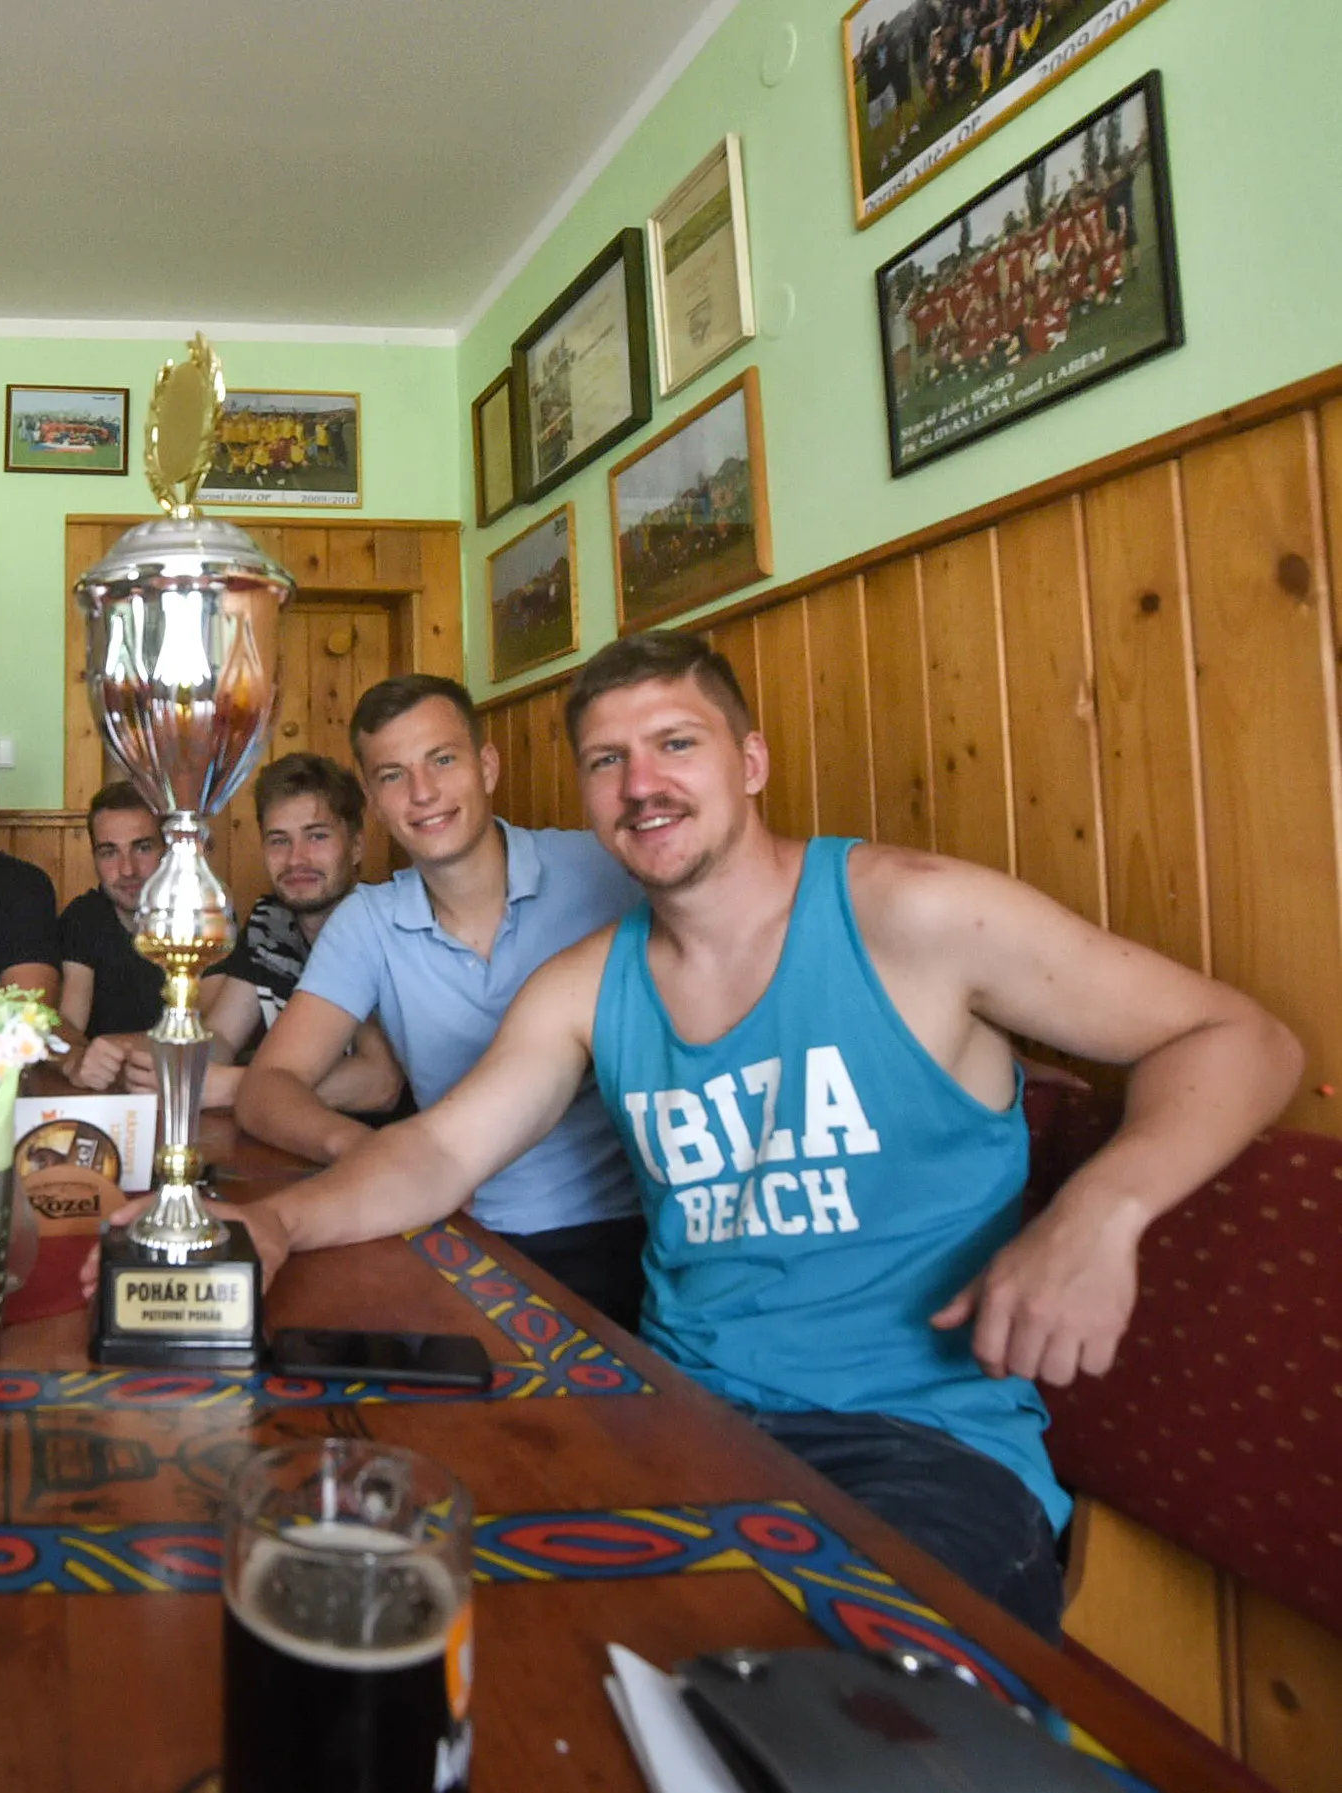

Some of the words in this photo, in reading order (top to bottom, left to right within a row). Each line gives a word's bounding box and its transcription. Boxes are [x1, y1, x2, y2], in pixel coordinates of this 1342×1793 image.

[624, 1045, 881, 1186] IBIZA
[674, 1167, 860, 1244] BEACH
[126, 1277, 189, 1302] POHÁR
